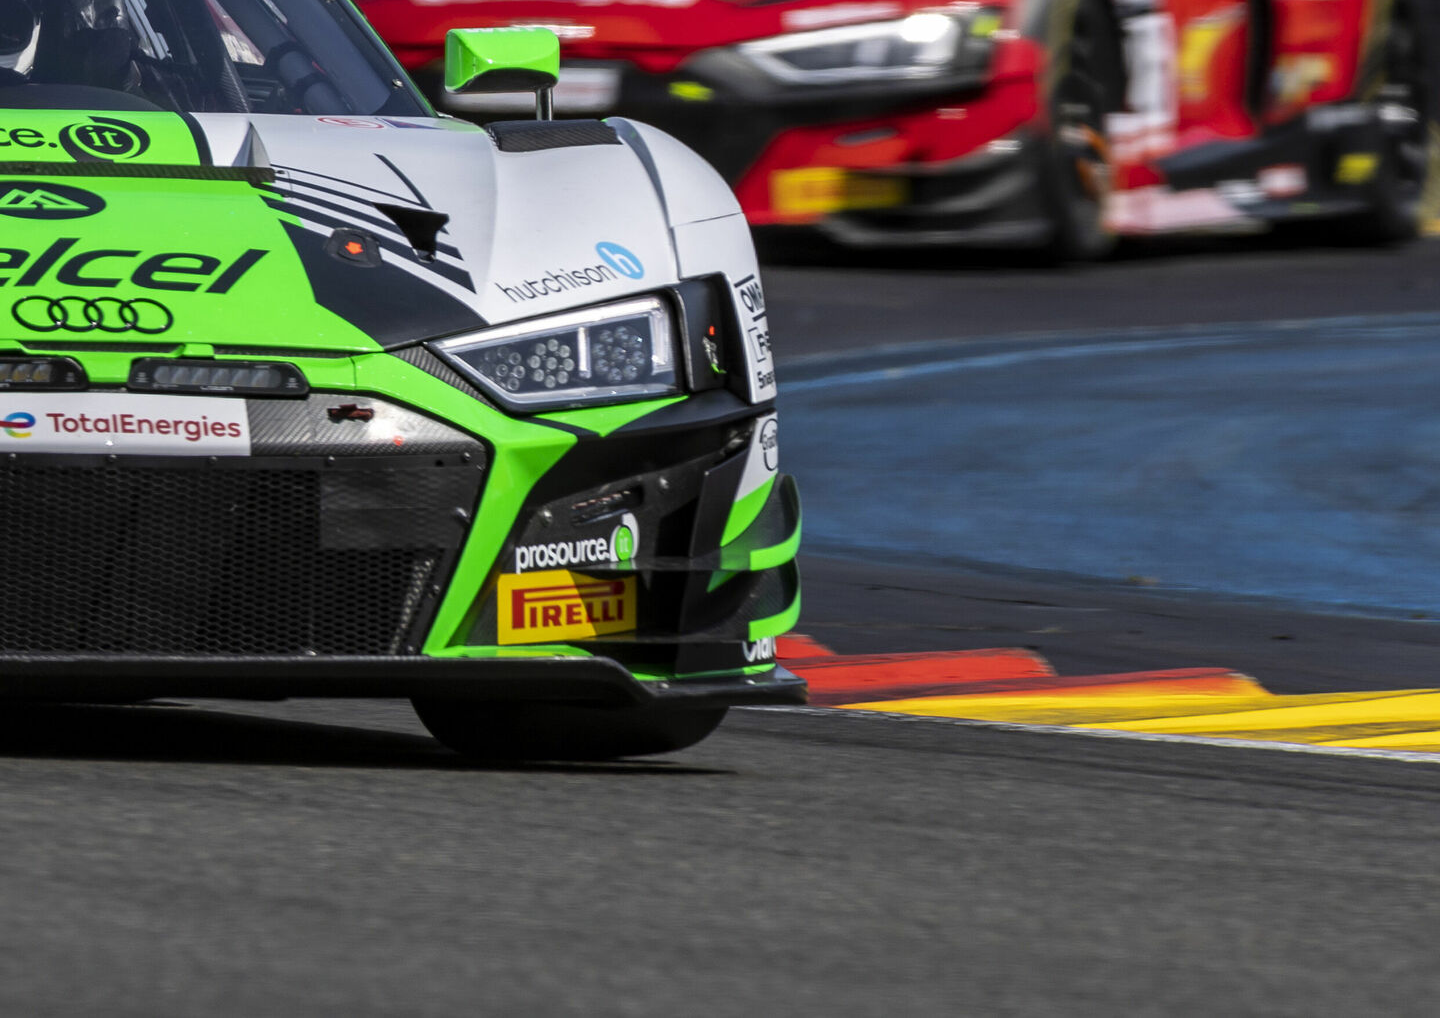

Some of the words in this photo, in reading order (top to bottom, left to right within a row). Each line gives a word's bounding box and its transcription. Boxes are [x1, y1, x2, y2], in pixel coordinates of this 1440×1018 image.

[495, 260, 616, 304] hutchison
[46, 412, 241, 439] TotalEnergies
[511, 580, 625, 629] PIRELLI
